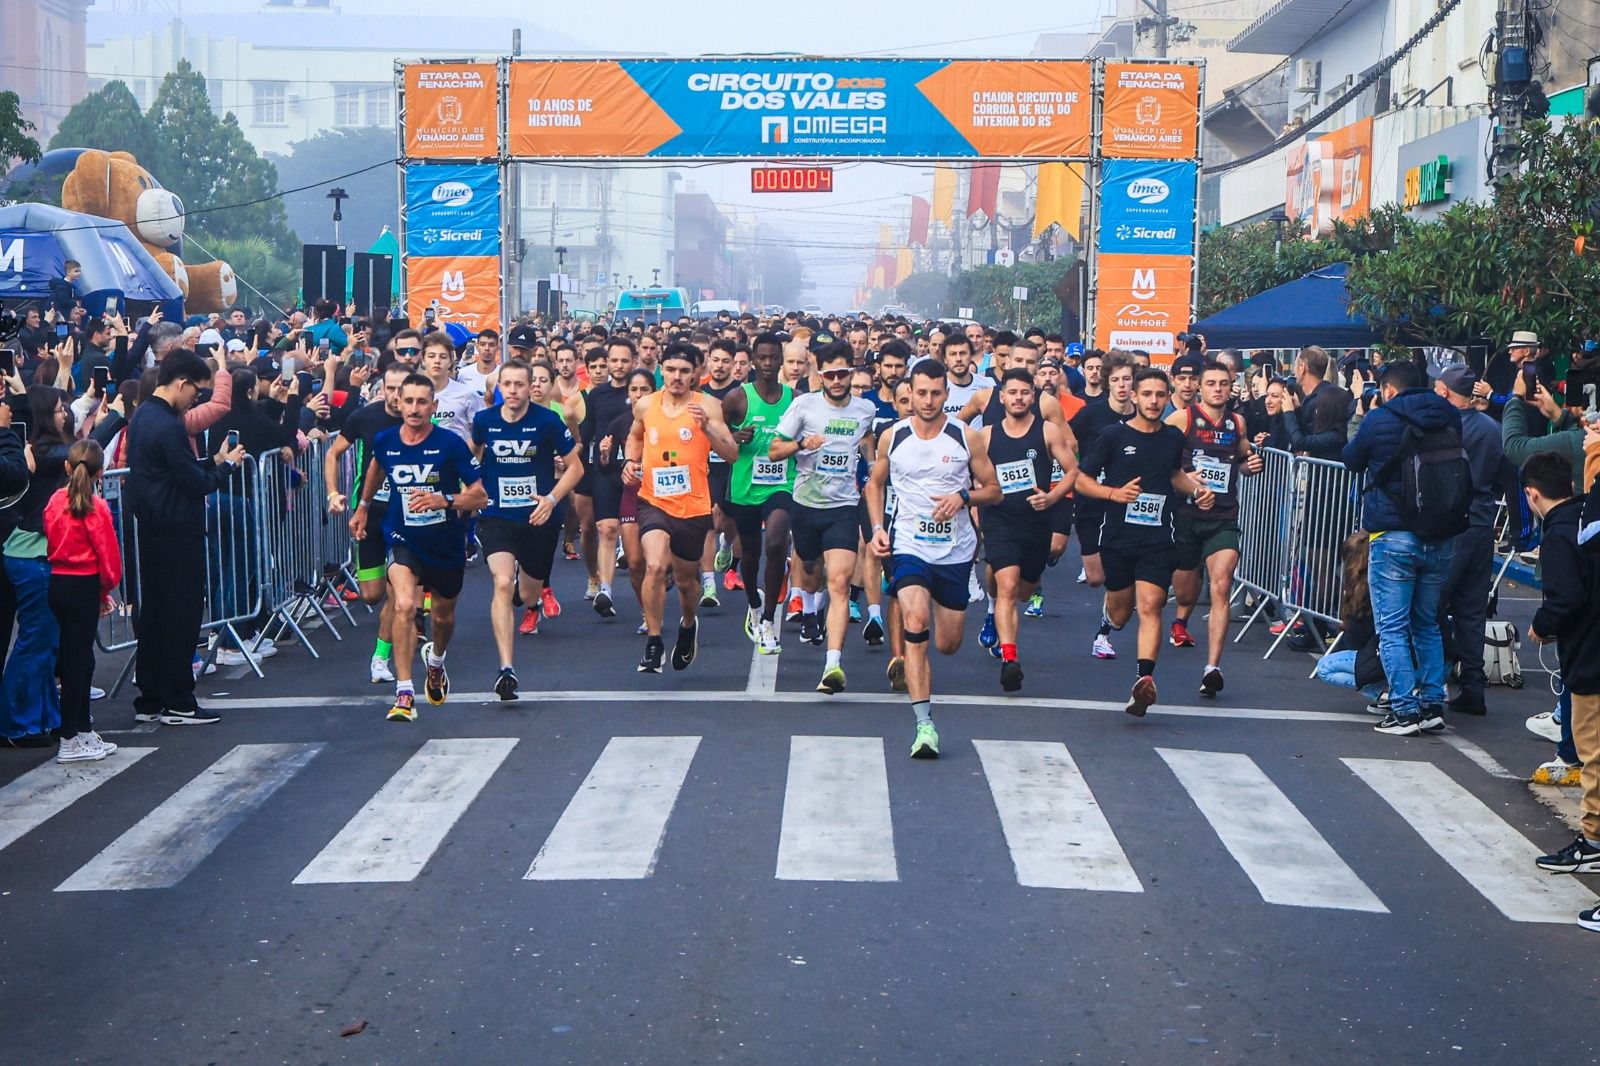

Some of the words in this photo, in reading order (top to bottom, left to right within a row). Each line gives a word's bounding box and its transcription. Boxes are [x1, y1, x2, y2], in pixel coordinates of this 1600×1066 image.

[420, 72, 461, 80] ETAPA
[462, 72, 481, 80] DA
[687, 72, 834, 92] CIRCUITO
[836, 77, 886, 89] 2025
[1120, 71, 1161, 80] ETAPA
[1163, 72, 1183, 81] DA
[417, 80, 484, 89] FENACHIM
[1117, 80, 1185, 90] FENACHIM
[720, 91, 786, 110] DOS
[789, 91, 887, 110] VALES
[973, 91, 981, 103] O
[982, 91, 1015, 103] MAIOR
[1016, 91, 1063, 103] CIRCUITO
[1065, 91, 1079, 103] DE
[527, 98, 541, 112] 10
[543, 98, 575, 112] ANOS
[577, 98, 593, 112] DE
[973, 103, 1016, 115] CORRIDA
[1018, 103, 1032, 115] DE
[1034, 103, 1054, 115] RUA
[1056, 103, 1071, 115] DO
[528, 111, 582, 127] HISTÓRIA
[793, 116, 887, 134] OMEGA
[972, 115, 1020, 127] INTERIOR
[1022, 115, 1036, 127] DO
[1038, 115, 1052, 127] RS
[461, 133, 485, 141] AIRES
[1158, 134, 1183, 143] AIRES
[753, 169, 831, 190] 000004
[1403, 156, 1446, 208] SUBWAY
[436, 185, 470, 198] imec
[1131, 182, 1166, 195] imec
[439, 229, 482, 241] Sicredi
[1132, 226, 1176, 240] Sicredi
[1115, 338, 1153, 347] Unimed
[943, 405, 965, 413] SAN
[824, 426, 856, 436] RUNNERS
[491, 439, 531, 456] CV
[822, 454, 849, 466] 3587
[390, 464, 434, 484] CV
[757, 463, 783, 474] 3586
[1002, 467, 1030, 482] 3612
[1200, 468, 1226, 482] 5582
[657, 474, 685, 487] 4178
[503, 485, 532, 496] 5593
[1132, 500, 1160, 513] 3584
[919, 521, 952, 534] 3605
